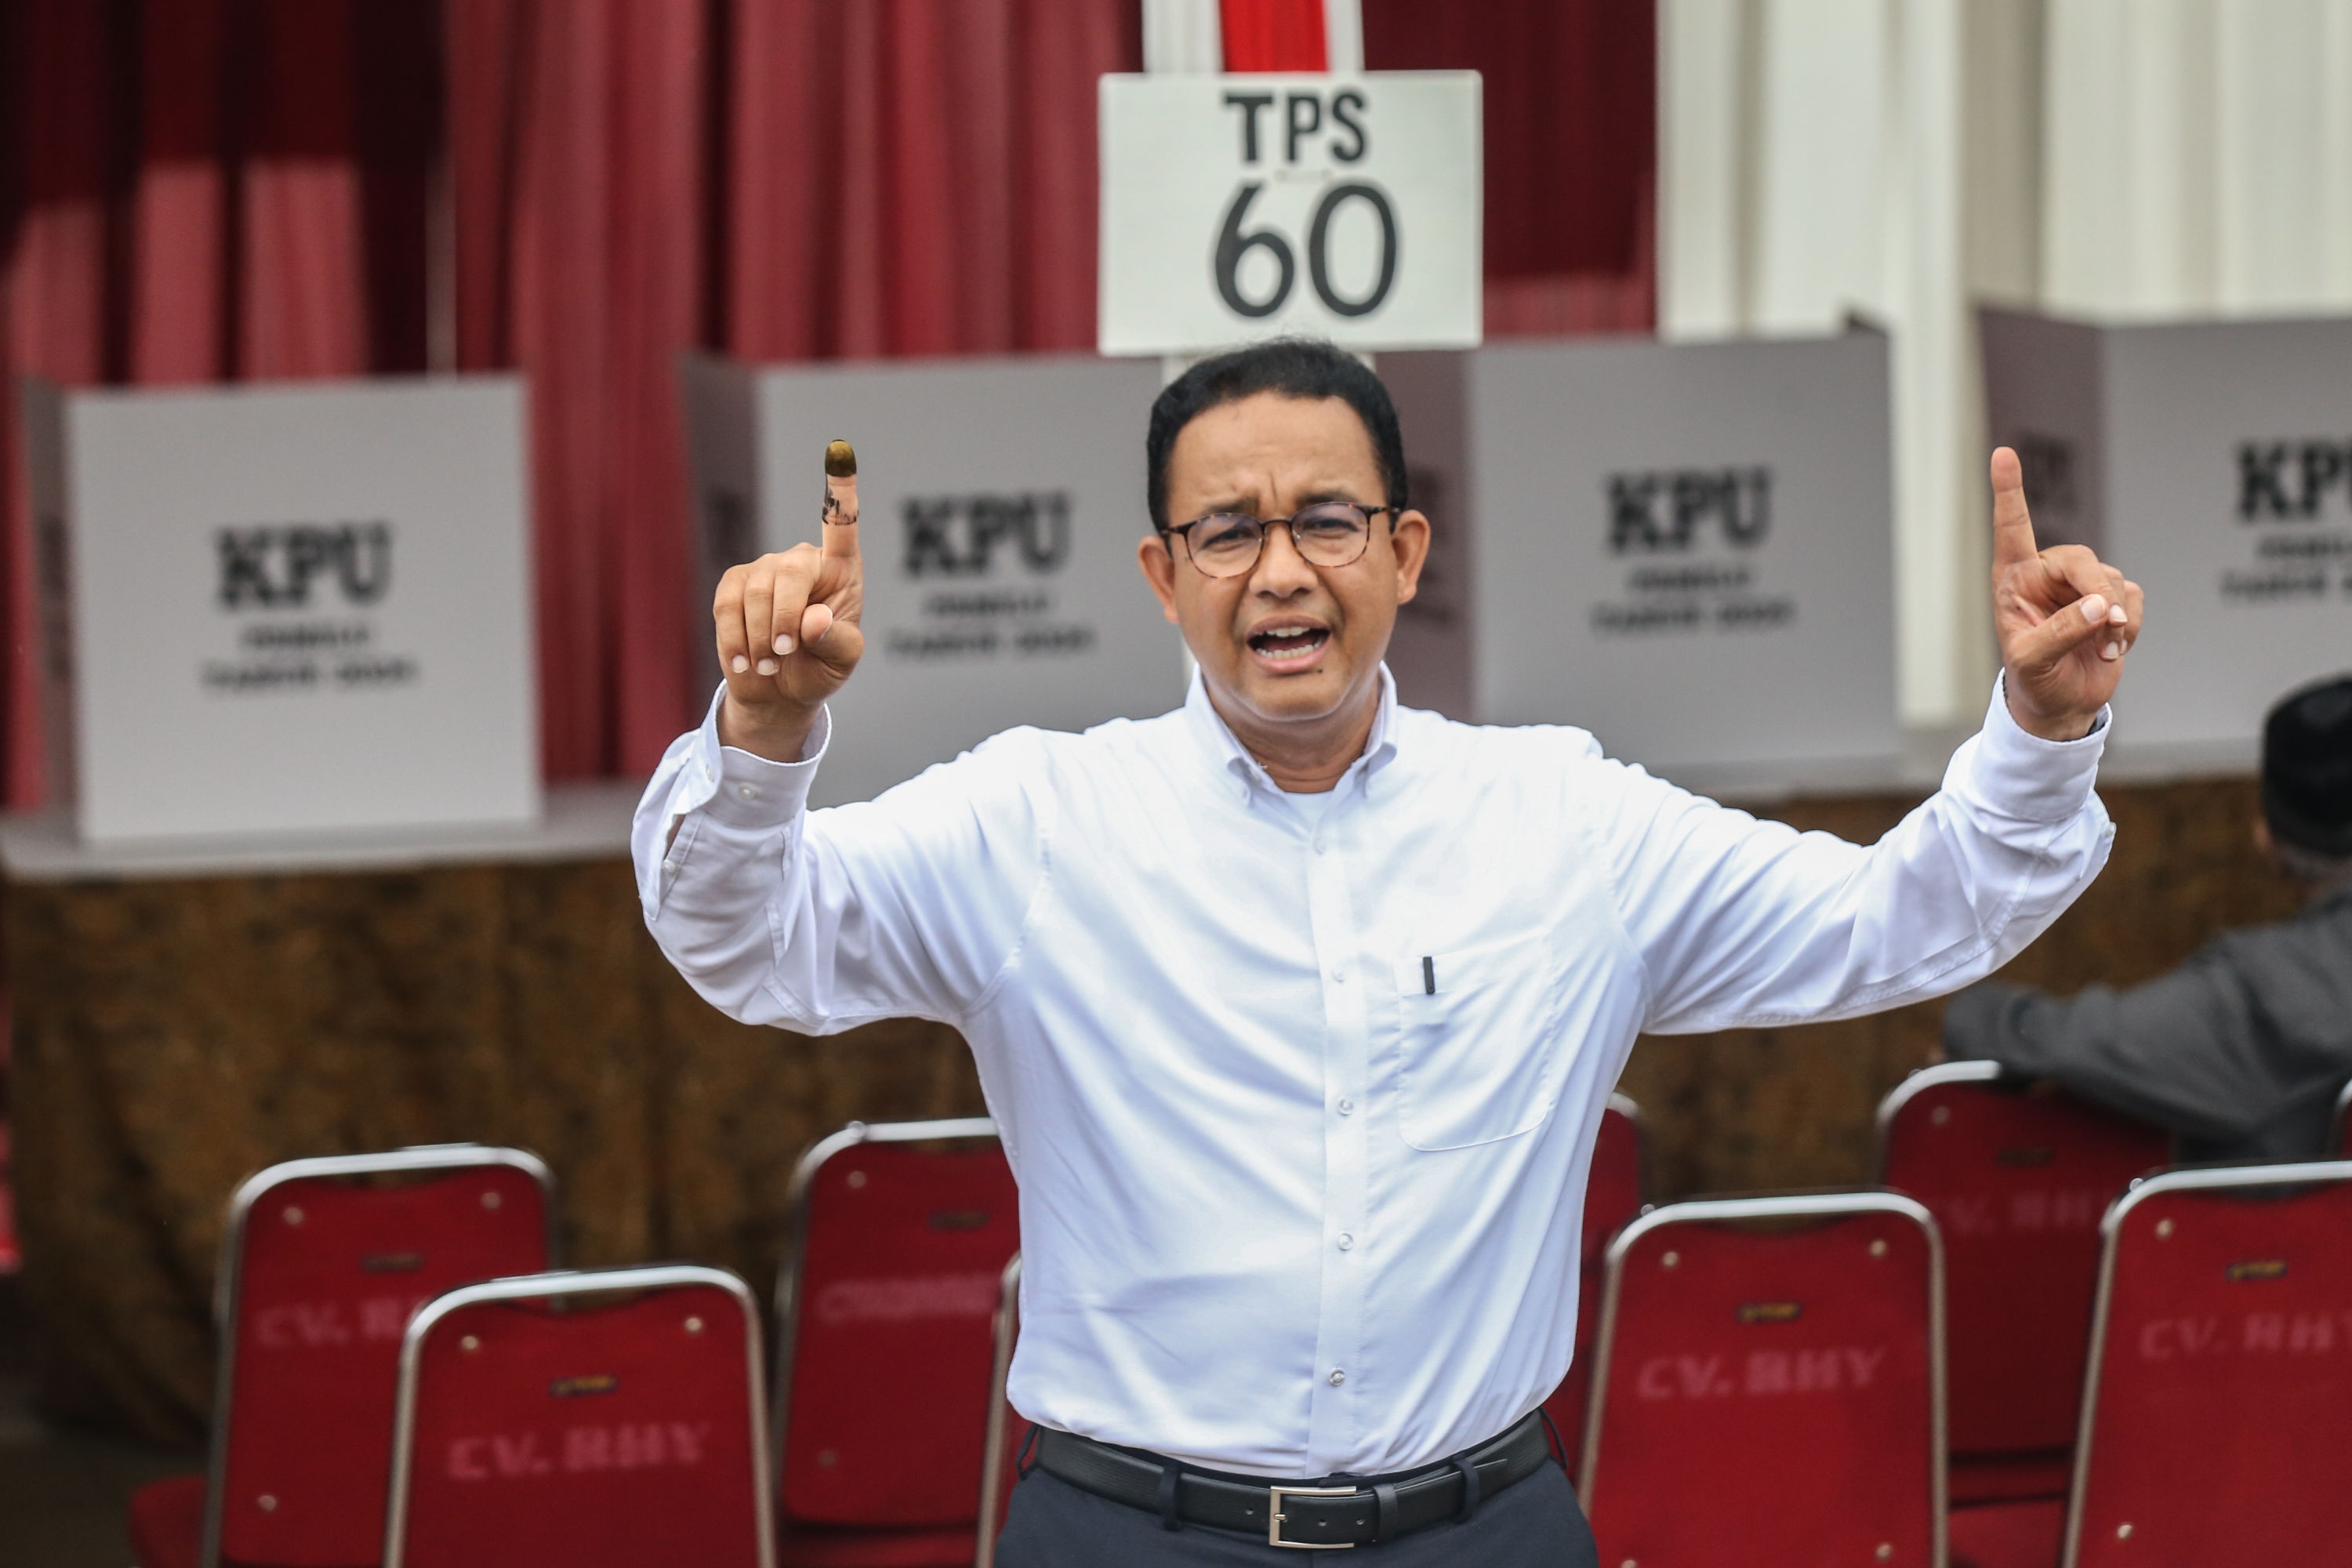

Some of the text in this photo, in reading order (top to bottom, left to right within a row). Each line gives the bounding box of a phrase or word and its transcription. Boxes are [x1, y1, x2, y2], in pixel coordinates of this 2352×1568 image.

[1222, 89, 1368, 164] TPS
[1212, 180, 1399, 320] 60
[1608, 470, 1769, 552] KPU
[2238, 441, 2352, 521] KP
[217, 524, 390, 610] KPU
[902, 495, 1068, 578] KPU
[1636, 1354, 1733, 1399] CV.
[448, 1433, 552, 1481] CV.
